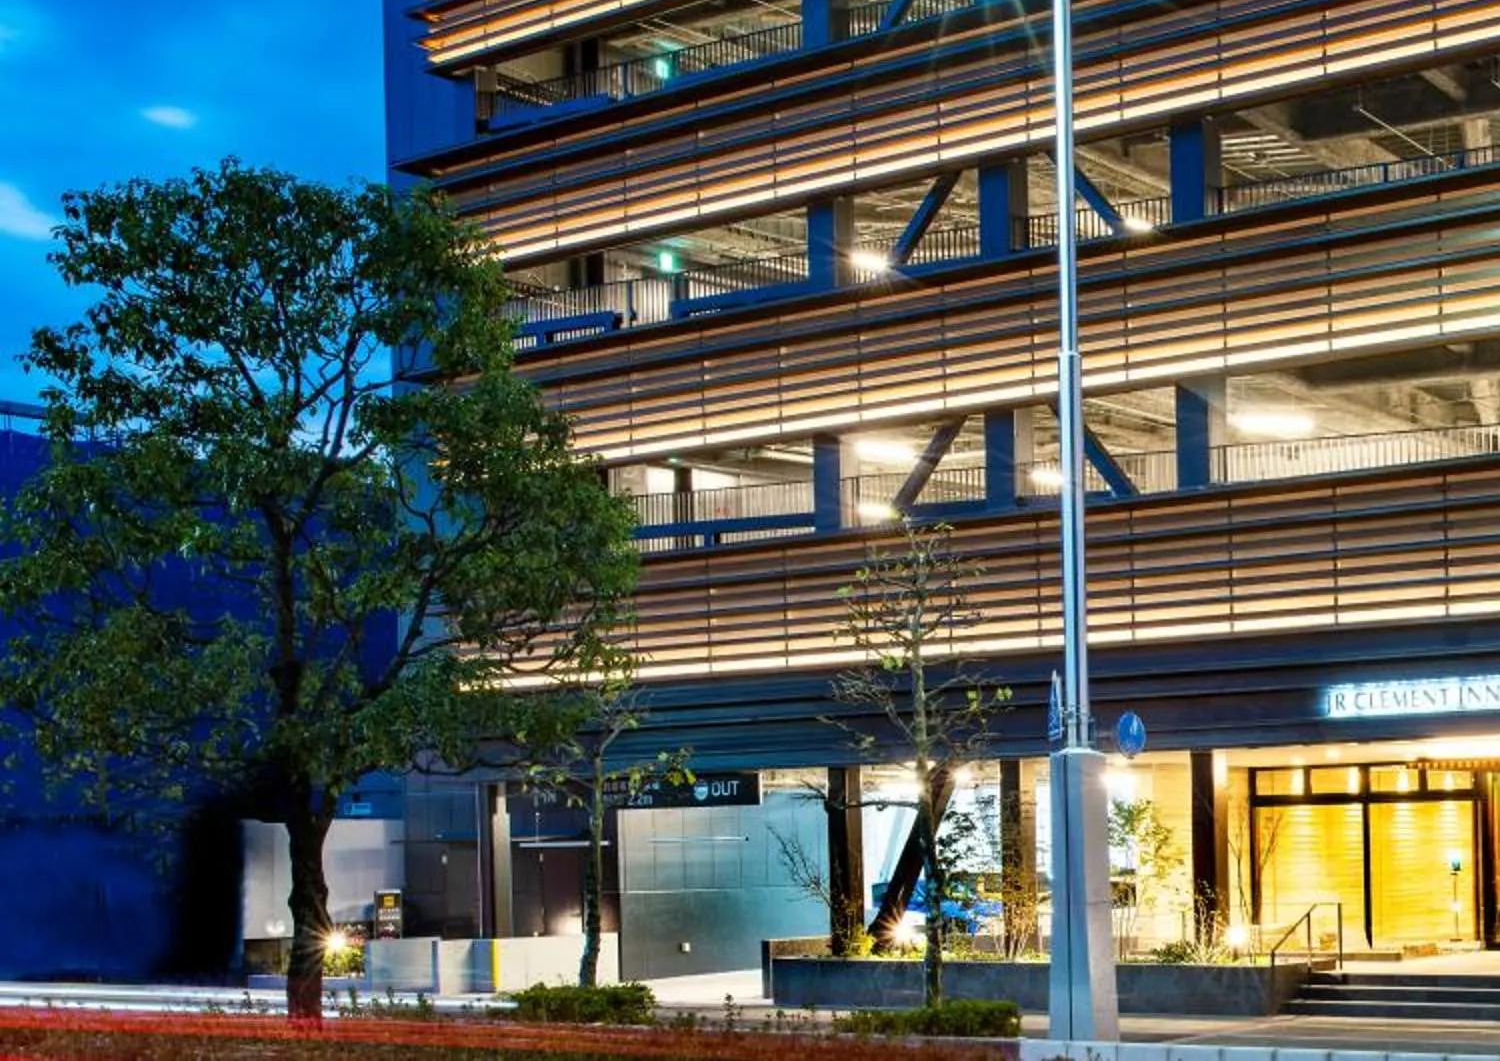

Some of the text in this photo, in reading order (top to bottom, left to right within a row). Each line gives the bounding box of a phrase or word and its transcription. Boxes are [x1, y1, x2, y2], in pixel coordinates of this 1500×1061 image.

[1327, 685, 1500, 713] JR CLEMENT INN
[711, 780, 740, 797] OUT
